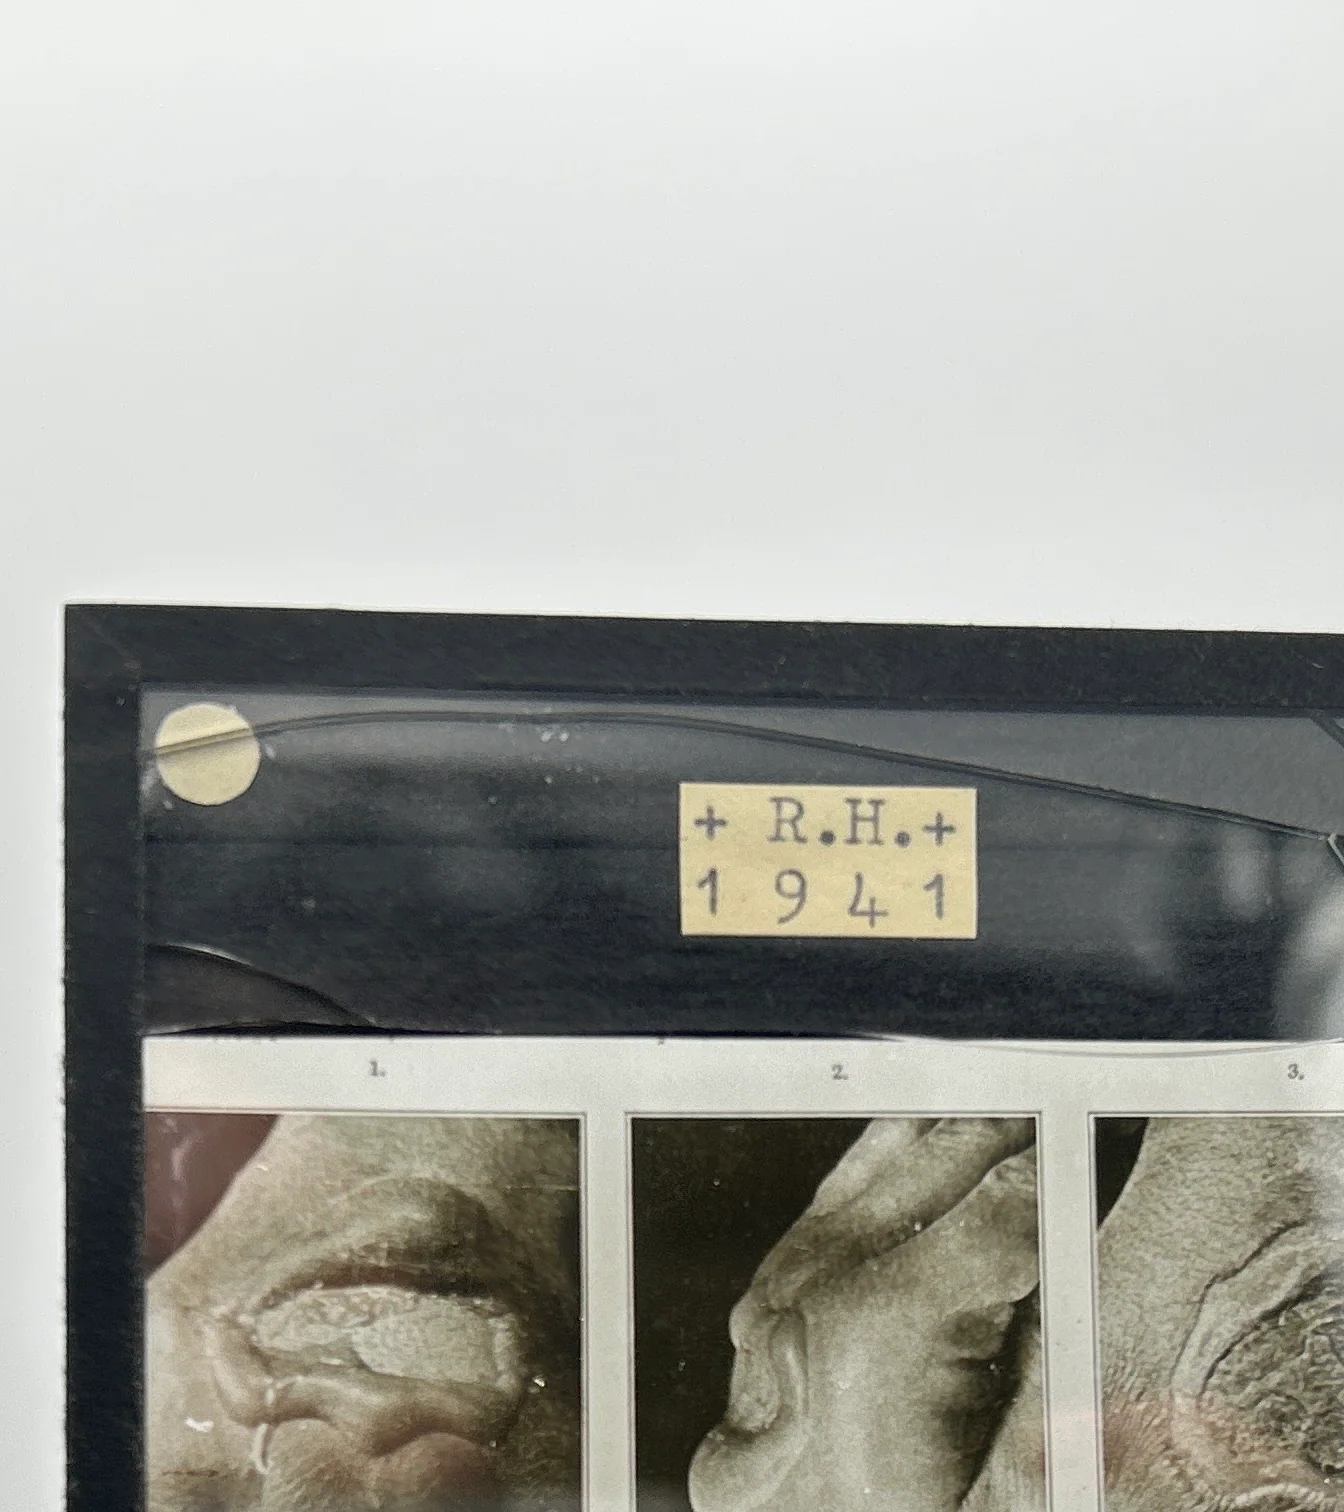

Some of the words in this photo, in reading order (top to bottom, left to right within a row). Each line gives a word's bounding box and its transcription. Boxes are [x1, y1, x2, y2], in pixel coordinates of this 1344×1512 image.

[369, 1059, 386, 1077] 1.
[831, 1064, 849, 1081] 2.
[1287, 1063, 1305, 1080] 3.
